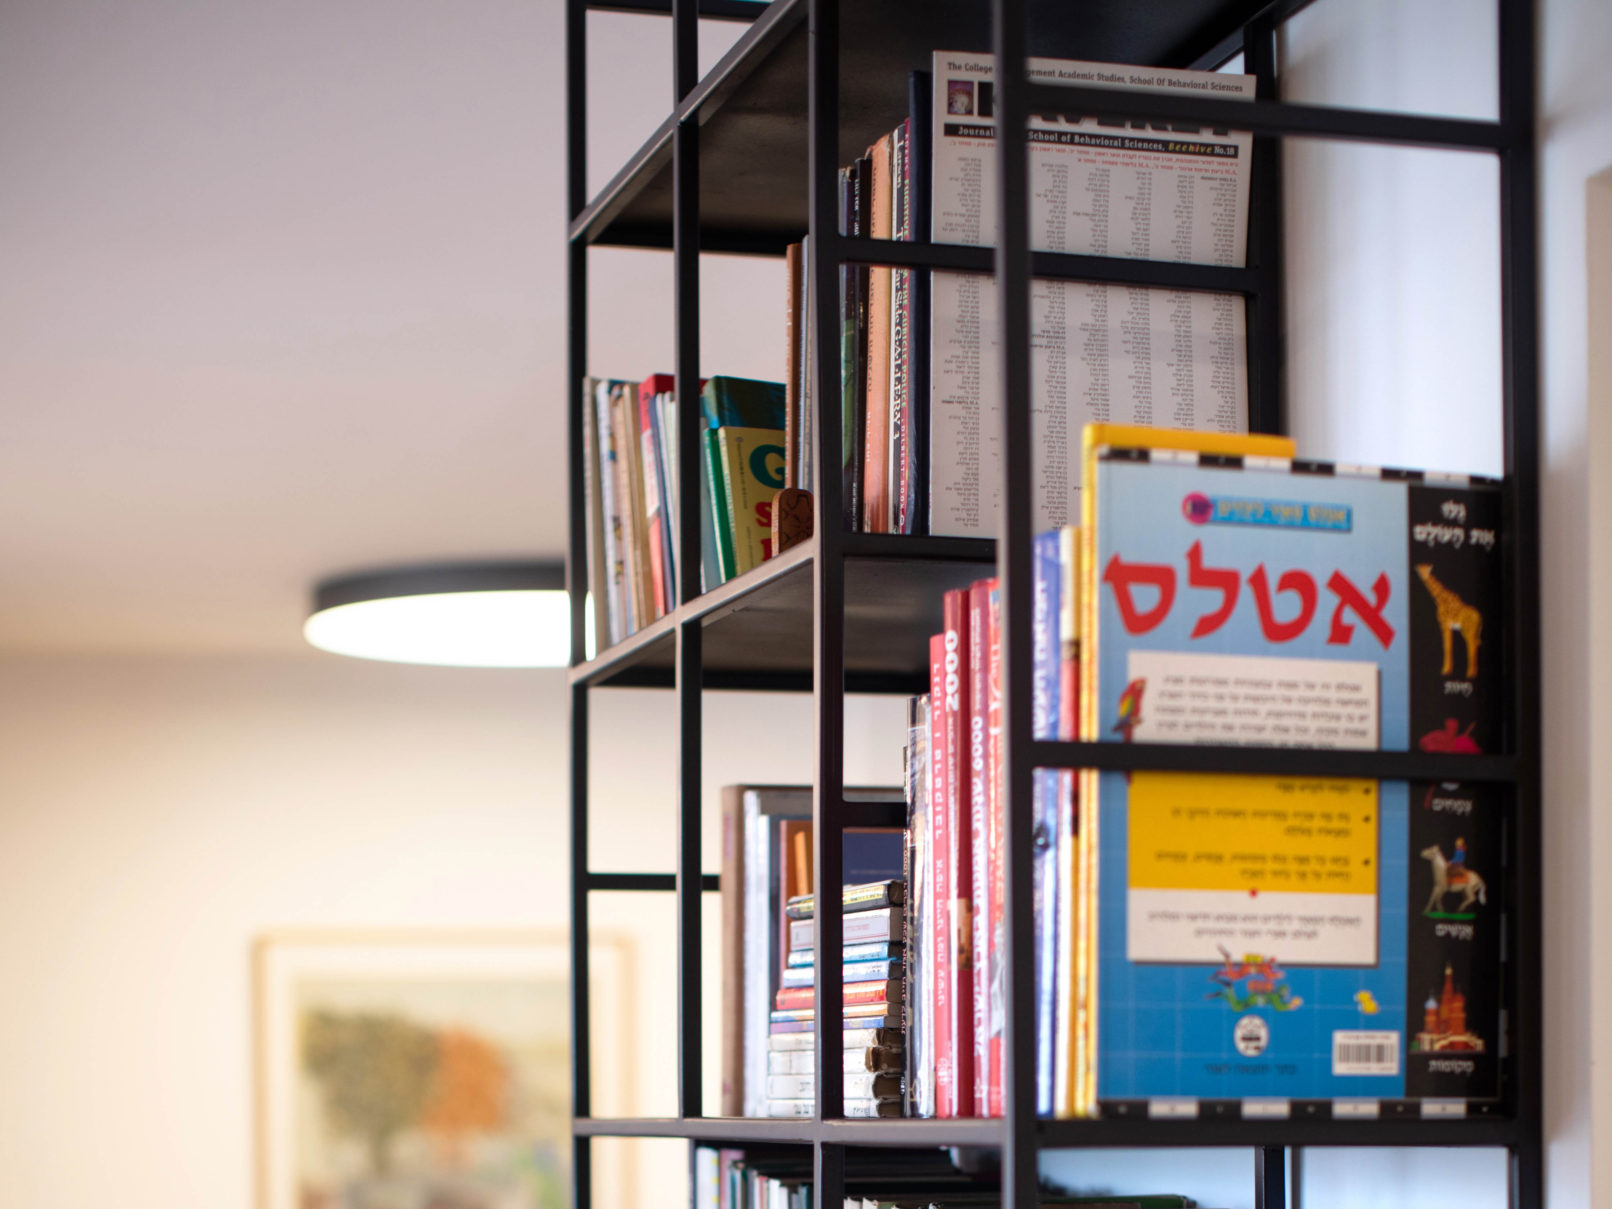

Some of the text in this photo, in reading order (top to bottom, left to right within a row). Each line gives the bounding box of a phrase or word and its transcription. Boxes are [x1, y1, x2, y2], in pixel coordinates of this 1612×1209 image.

[948, 62, 1243, 93] The College gement Academic Studies, School Of Behavioral Sciences
[958, 126, 994, 137] Journal
[1028, 131, 1058, 143] School
[1060, 132, 1072, 143] of
[1074, 135, 1122, 147] Behavioral
[1124, 138, 1166, 151] Sciences,
[1168, 141, 1213, 153] Beehive
[901, 312, 909, 360] CUBICLE
[900, 364, 908, 408] POLICE
[1101, 537, 1397, 652] אטלס
[932, 662, 942, 722] דנקנר
[944, 629, 959, 713] 2000
[970, 716, 984, 771] 6000
[935, 858, 946, 1007] איפה היינו ומה עשינו
